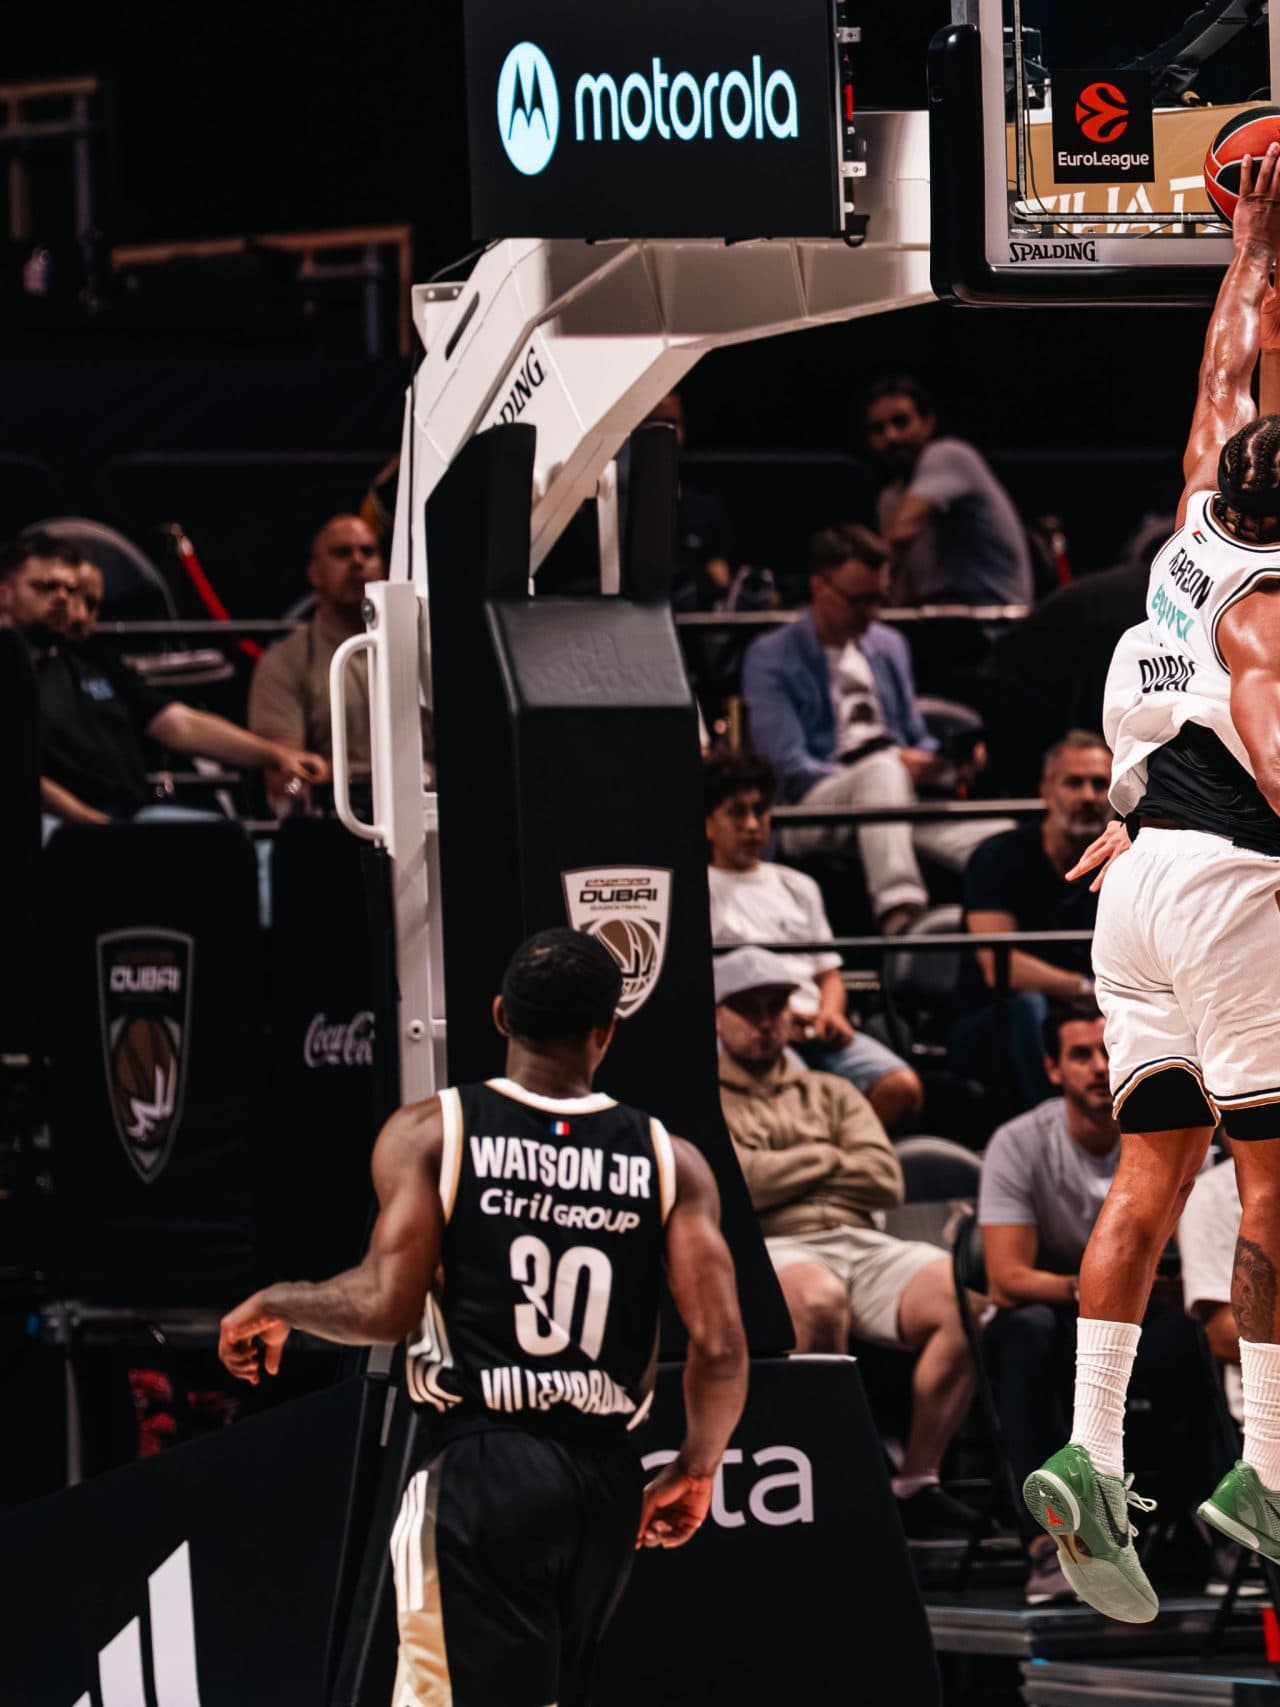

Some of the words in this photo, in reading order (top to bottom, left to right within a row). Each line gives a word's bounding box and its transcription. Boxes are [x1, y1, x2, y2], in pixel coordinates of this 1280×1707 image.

[574, 54, 799, 141] motorola
[1057, 151, 1150, 171] EuroLeague
[1009, 240, 1097, 264] SPALDING
[579, 888, 658, 904] DUBAI
[109, 964, 182, 993] DUBAI
[469, 1135, 604, 1192] WATSON
[608, 1152, 651, 1199] JR
[509, 1234, 613, 1362] 30
[640, 1445, 815, 1529] ta
